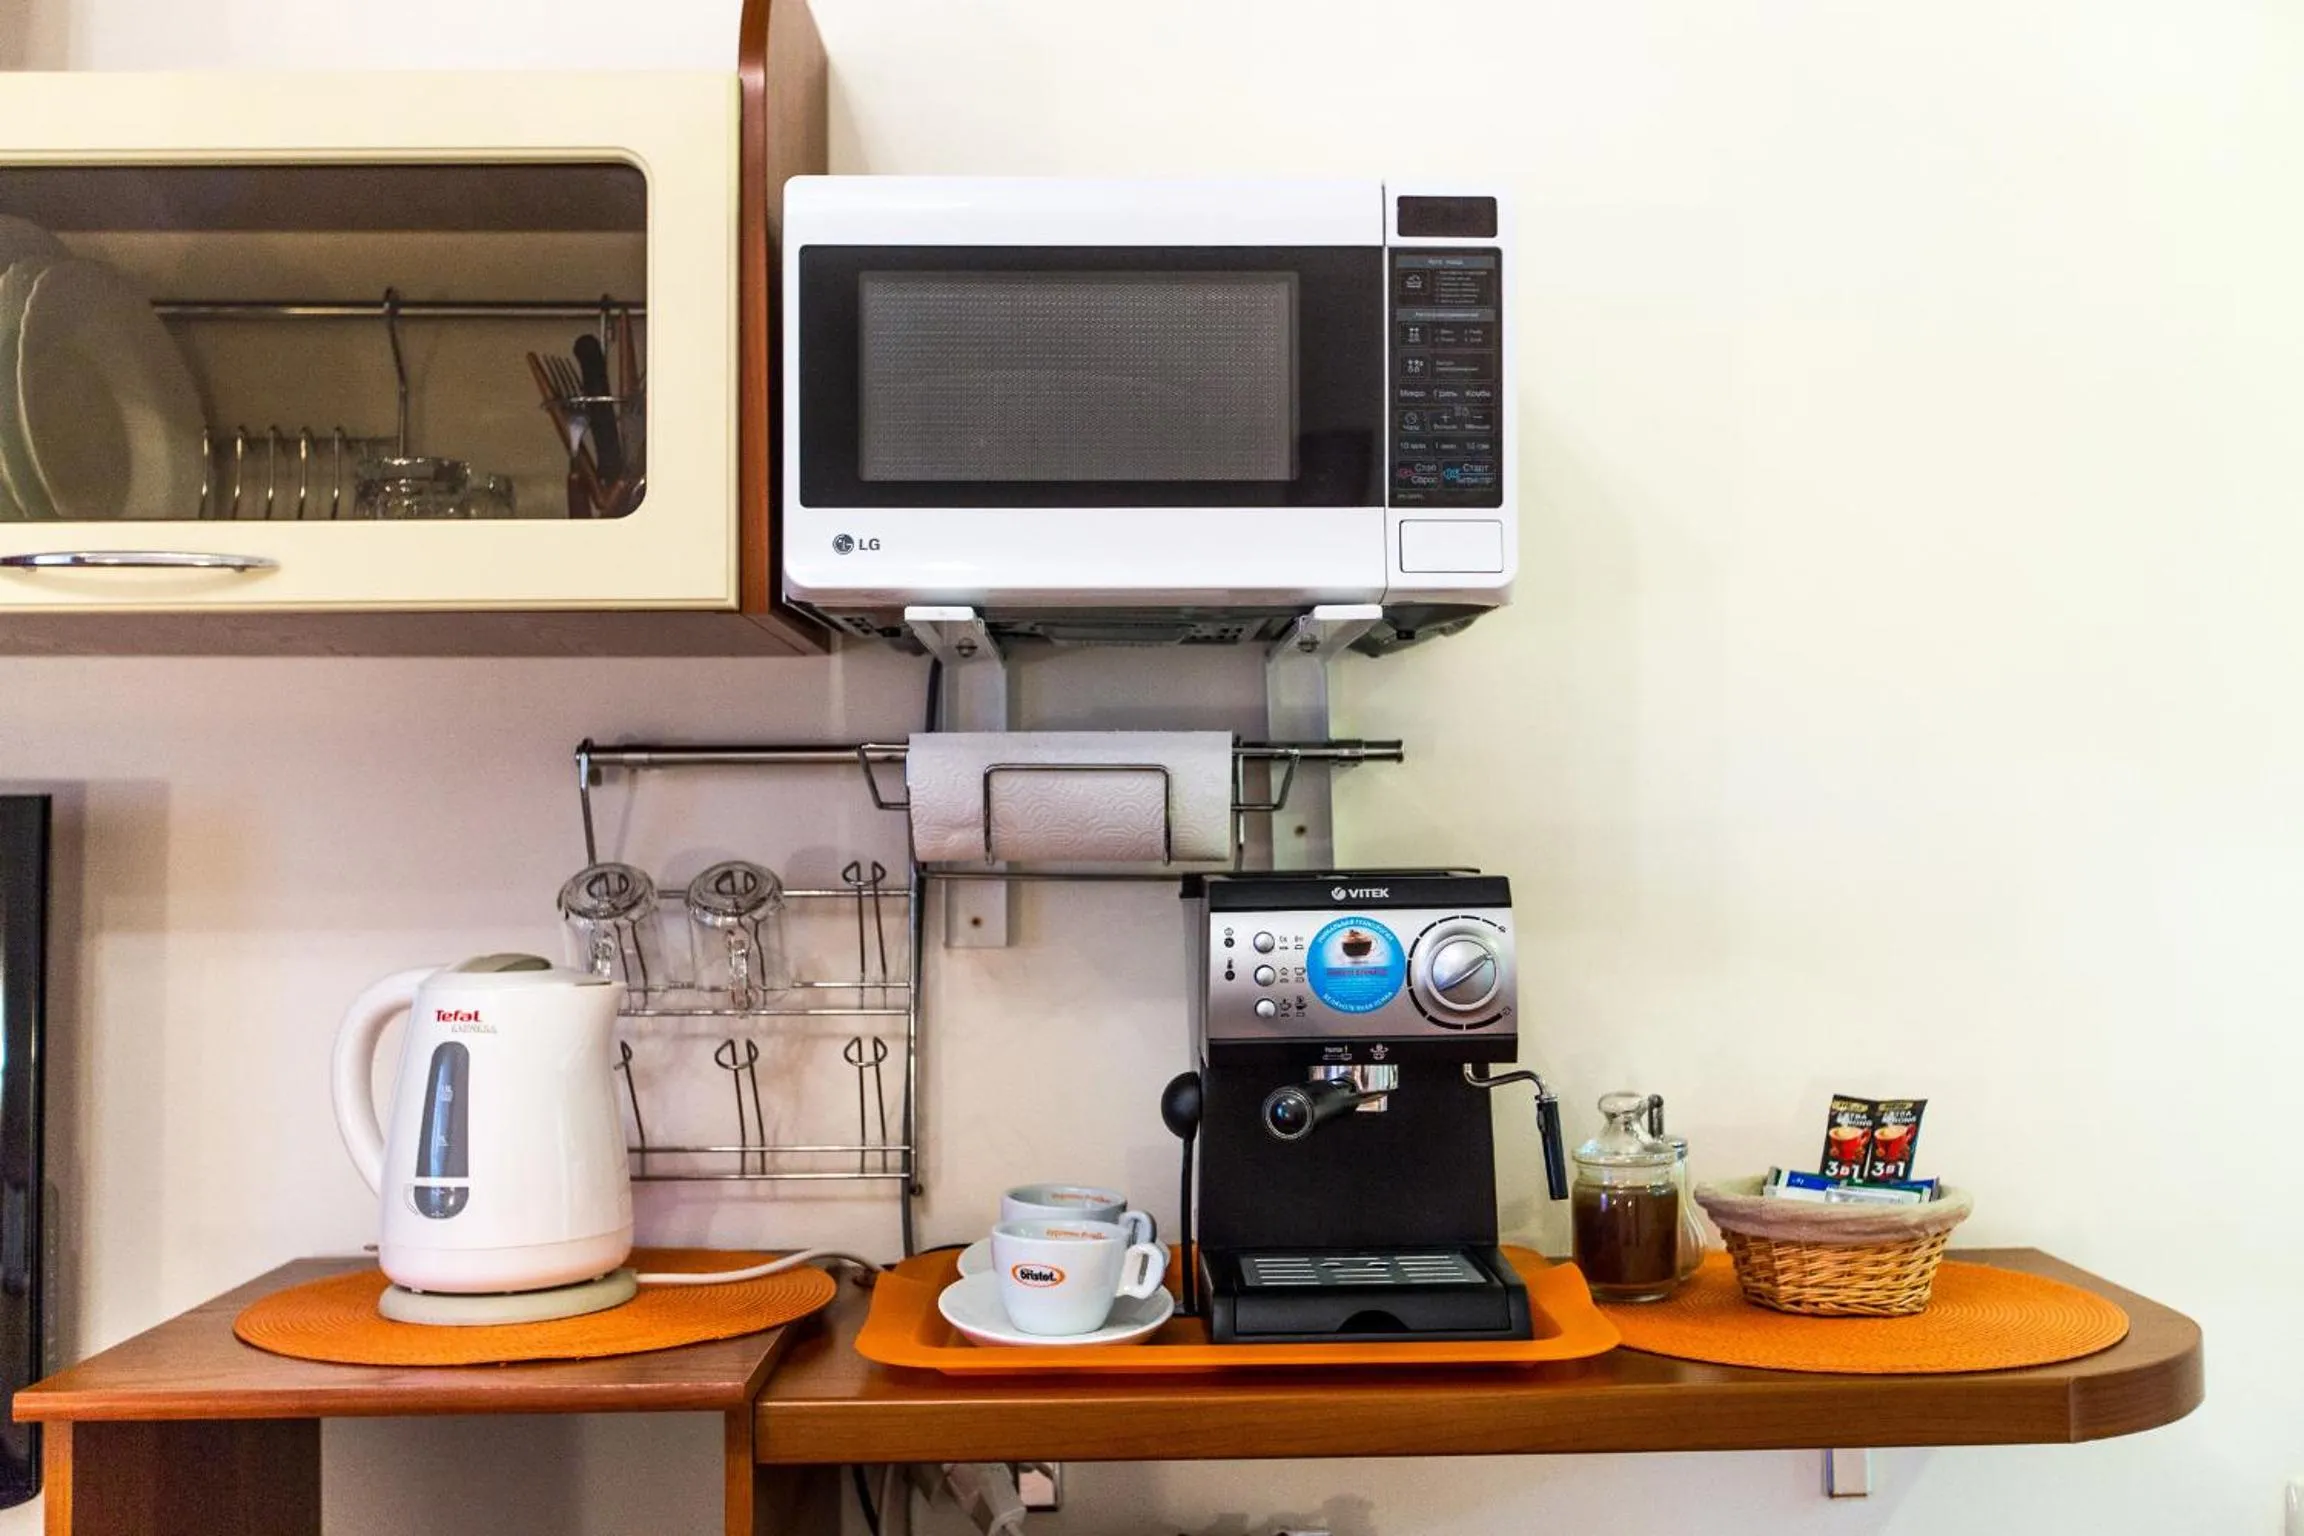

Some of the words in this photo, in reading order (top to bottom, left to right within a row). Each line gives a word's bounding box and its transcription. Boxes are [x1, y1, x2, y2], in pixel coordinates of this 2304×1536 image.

[859, 538, 881, 551] LG
[1347, 887, 1390, 898] VITEK
[435, 1010, 483, 1023] Tefal
